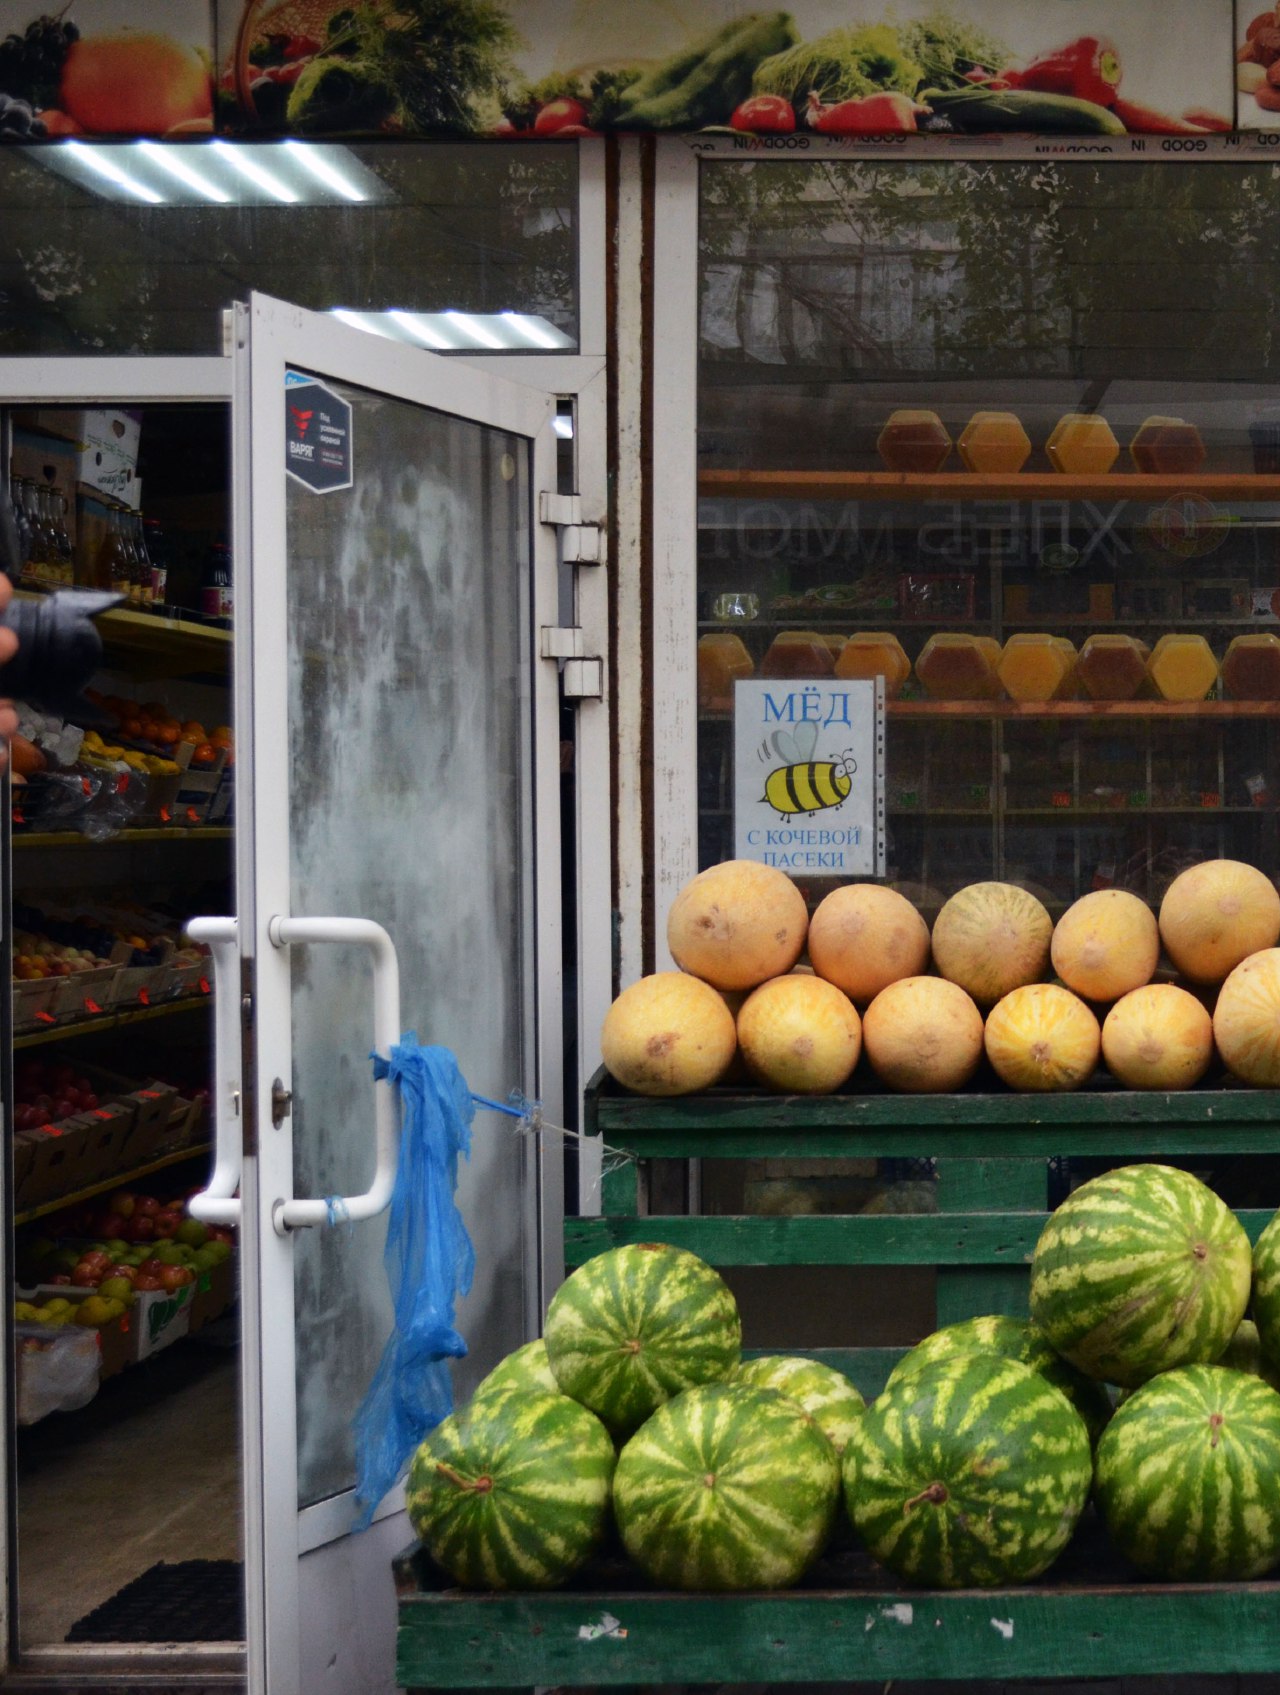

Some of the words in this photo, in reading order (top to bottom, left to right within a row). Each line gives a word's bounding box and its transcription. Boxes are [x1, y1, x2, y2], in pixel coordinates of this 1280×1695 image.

[290, 441, 315, 458] ВАРЯГ
[763, 686, 852, 729] МЁД
[747, 829, 761, 845] С
[766, 826, 861, 845] КОЧЕВОЙ
[764, 852, 844, 867] ПАСЕКИ
